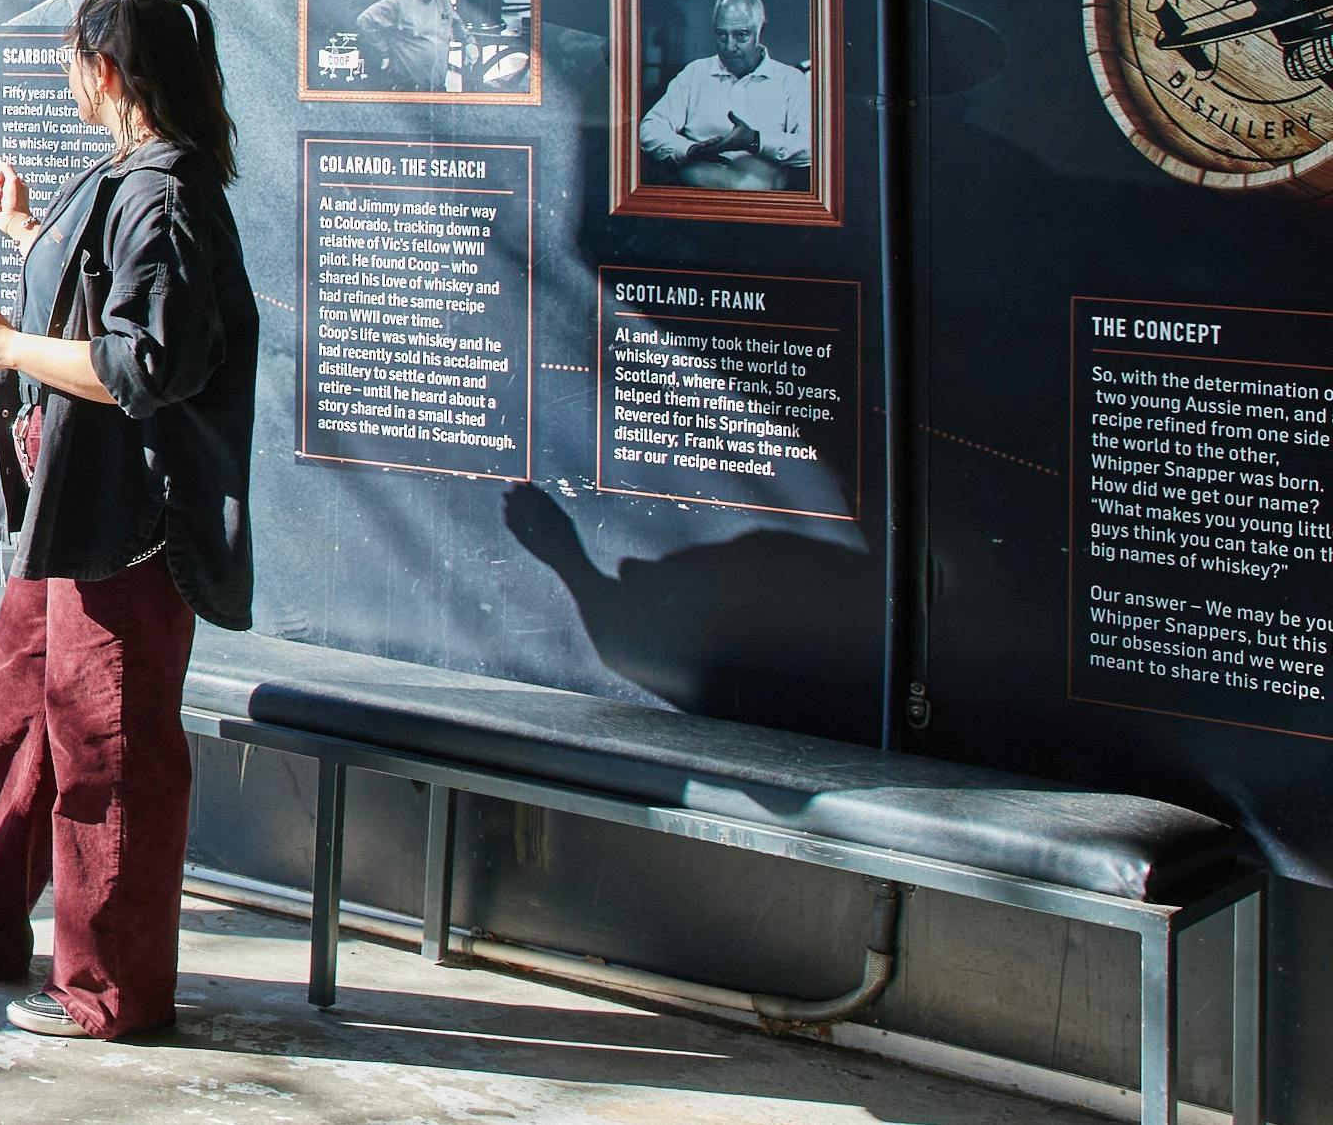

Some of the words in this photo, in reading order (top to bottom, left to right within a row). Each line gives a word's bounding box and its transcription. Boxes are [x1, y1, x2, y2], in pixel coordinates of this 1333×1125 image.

[2, 86, 26, 101] Fifty
[28, 88, 55, 101] years
[1168, 70, 1313, 139] DISTILLERY
[2, 104, 42, 116] reached
[2, 121, 41, 133] veteran
[42, 121, 59, 133] Vic
[2, 136, 17, 149] his
[19, 137, 59, 152] whiskey
[61, 139, 80, 151] and
[19, 154, 43, 167] back
[45, 155, 68, 168] shed
[70, 156, 80, 168] in
[319, 154, 397, 176] COLARADO:
[399, 157, 427, 177] THE
[430, 159, 486, 179] SEARCH
[25, 171, 57, 184] stroke
[319, 196, 334, 211] Al
[334, 197, 357, 212] and
[358, 198, 401, 217] Jimmy
[402, 201, 437, 216] made
[438, 202, 470, 218] their
[470, 206, 497, 222] way
[318, 269, 360, 286] shared
[361, 272, 380, 287] his
[381, 273, 408, 289] love
[408, 275, 423, 290] of
[423, 276, 474, 296] whiskey
[475, 280, 500, 296] and
[615, 282, 704, 307] SCOTLAND:
[711, 289, 765, 311] FRANK
[614, 326, 631, 343] Al
[632, 329, 658, 345] and
[660, 331, 708, 351] Jimmy
[711, 335, 743, 351] took
[746, 338, 780, 354] their
[783, 340, 813, 357] love
[816, 343, 832, 358] of
[1091, 316, 1127, 338] THE
[1134, 319, 1222, 345] CONCEPT
[318, 342, 341, 358] had
[342, 347, 393, 365] recently
[394, 349, 421, 365] sold
[422, 351, 442, 367] his
[442, 354, 509, 373] acclaimed
[612, 346, 670, 368] whiskey
[671, 354, 717, 370] across
[720, 356, 744, 372] the
[747, 360, 787, 375] world
[791, 363, 806, 377] to
[614, 385, 661, 405] helped
[663, 390, 701, 408] them
[703, 395, 745, 413] refine
[746, 399, 782, 415] their
[785, 404, 834, 422] recipe.
[317, 418, 358, 433] across
[358, 419, 380, 435] the
[380, 423, 416, 439] world
[418, 425, 430, 441] in
[431, 426, 517, 452] Scarborough.
[614, 405, 670, 425] Revered
[672, 411, 694, 427] for
[695, 413, 717, 430] his
[718, 415, 800, 438] Springbank
[1092, 412, 1143, 431] recipe
[1147, 416, 1206, 435] refined
[1211, 420, 1252, 440] from
[1257, 428, 1289, 443] one
[1293, 429, 1330, 447] side
[1091, 453, 1161, 476] Whipper
[1164, 460, 1236, 484] Snapper
[1239, 472, 1274, 487] was
[1279, 472, 1324, 493] born.
[1091, 475, 1128, 494] How
[1132, 480, 1158, 497] did
[1162, 486, 1187, 500] we
[1191, 489, 1220, 505] get
[1224, 493, 1254, 507] our
[1259, 497, 1320, 515] name?
[1090, 606, 1161, 631] Whipper
[1164, 617, 1251, 645] Snappers,
[1257, 629, 1287, 649] but
[1292, 635, 1327, 654] this
[1090, 632, 1118, 647] our
[1122, 634, 1207, 660] obsession
[1212, 649, 1244, 665] and
[1249, 654, 1274, 670] we
[1279, 659, 1324, 677] were
[1090, 654, 1145, 673] meant
[1149, 660, 1166, 676] to
[1171, 664, 1220, 684] share
[1224, 671, 1258, 690] this
[1263, 679, 1325, 700] recipe.
